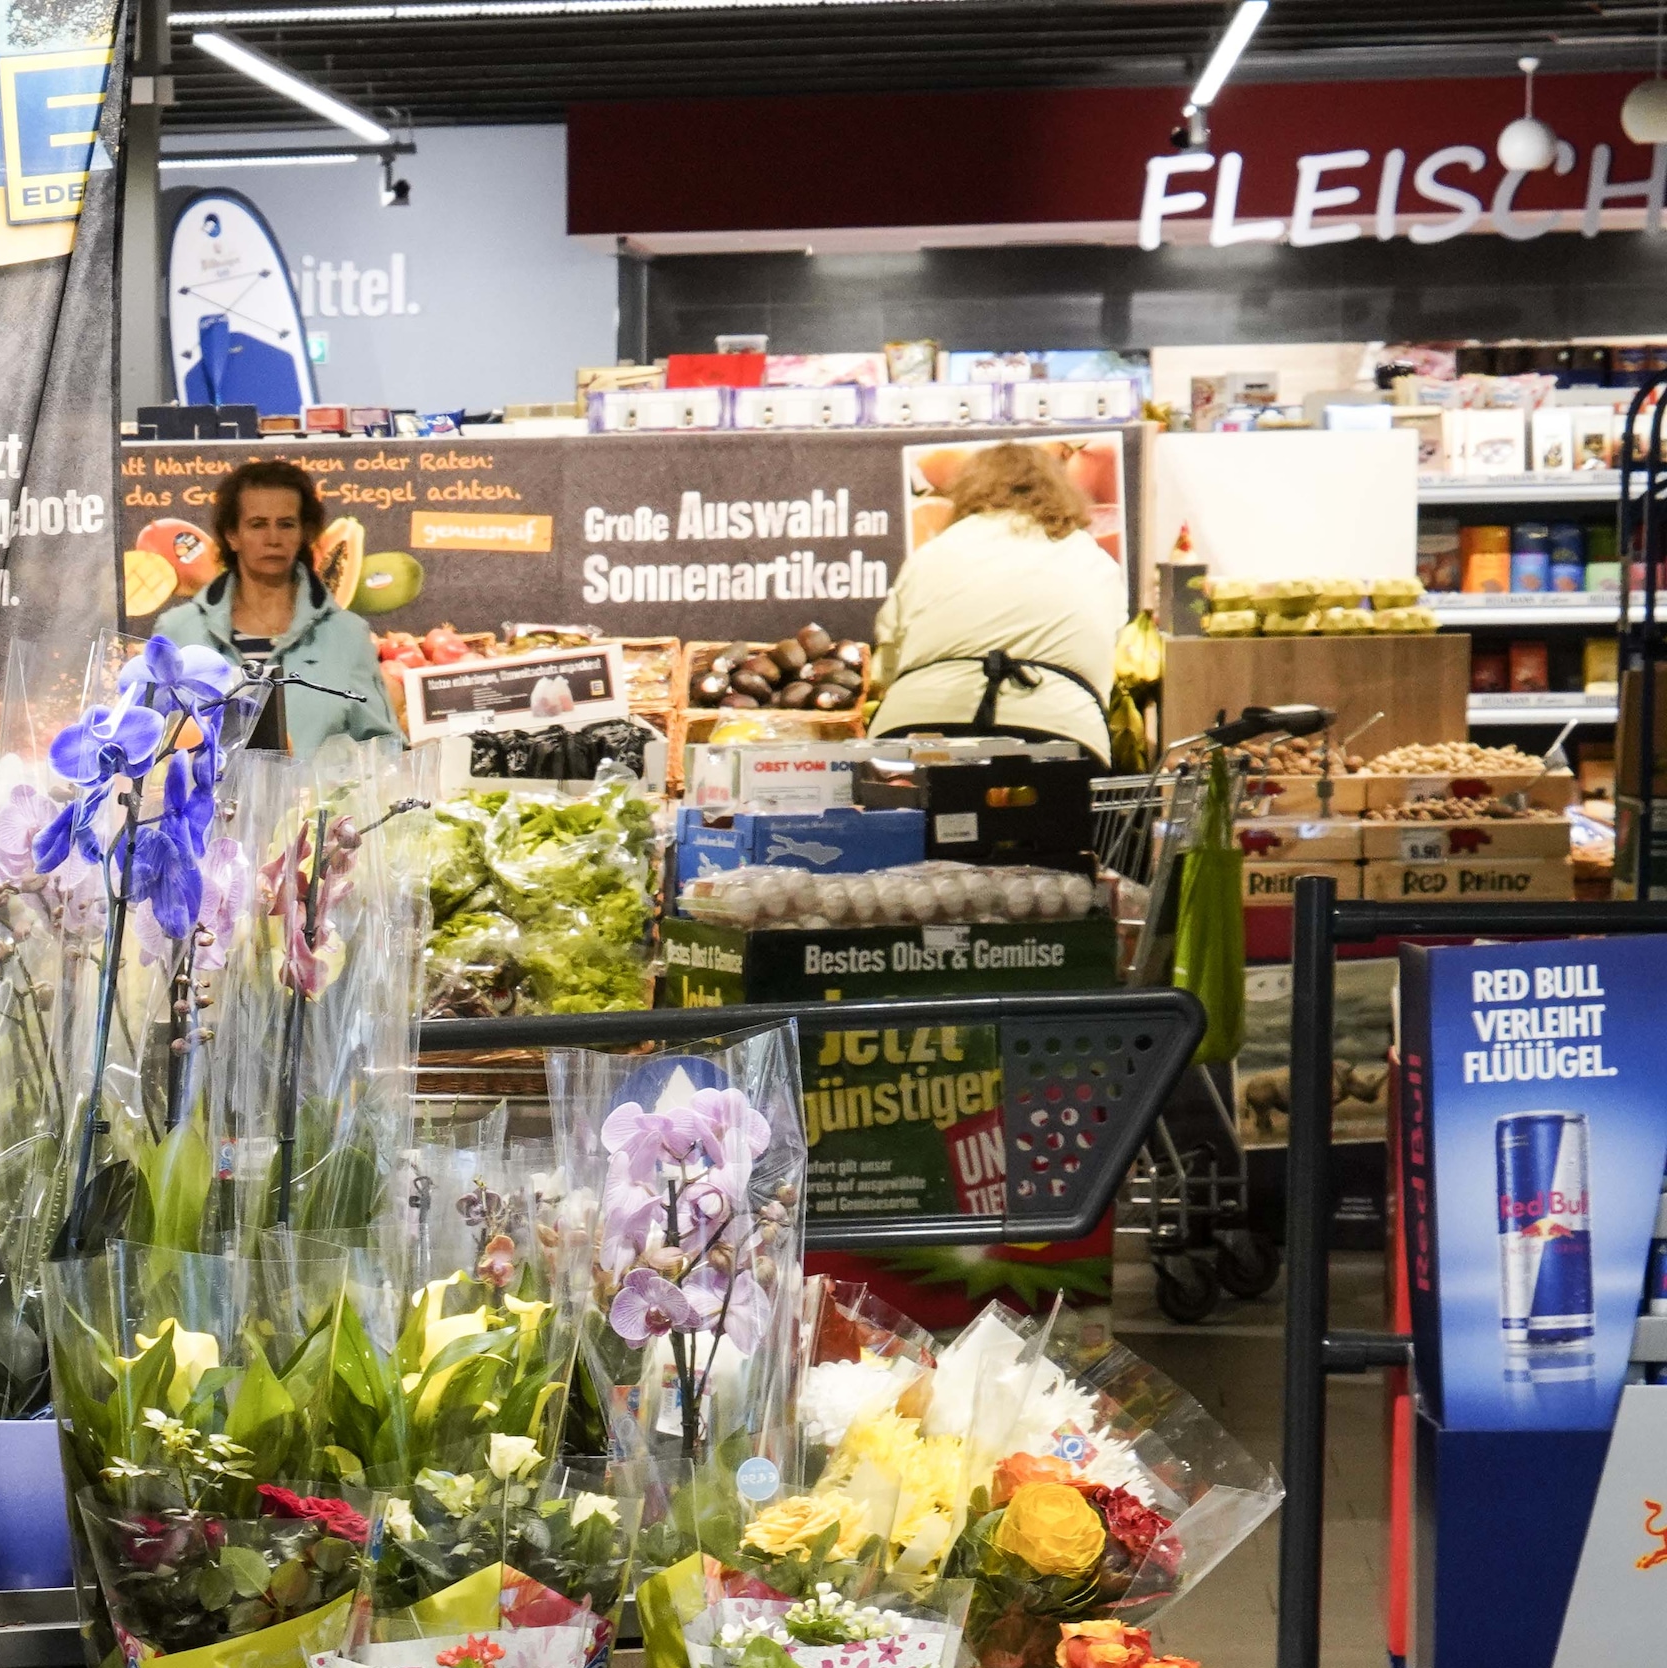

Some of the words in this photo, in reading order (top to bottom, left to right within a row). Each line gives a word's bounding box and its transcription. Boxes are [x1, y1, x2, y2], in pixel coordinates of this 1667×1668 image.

[22, 182, 86, 207] EDE
[1138, 144, 1667, 253] FLEISCH
[288, 252, 422, 318] ittel.
[353, 450, 411, 471] oder
[419, 450, 494, 472] Raten:
[126, 483, 172, 506] das
[426, 479, 522, 501] achten.
[422, 519, 538, 543] genussreif
[584, 505, 670, 543] Große
[677, 488, 848, 541] Auswahl
[854, 507, 888, 537] an
[583, 550, 889, 604] Sonnenartikeln
[753, 761, 789, 773] OBST
[793, 760, 827, 772] VOM
[804, 943, 886, 975] Bestes
[892, 939, 946, 972] Obst
[972, 938, 1066, 970] Gemüse
[1472, 968, 1530, 1004] RED
[1534, 964, 1605, 1000] BULL
[1472, 1004, 1606, 1043] VERLEIHT
[1463, 1040, 1619, 1084] FLÜÜÜGEL.
[806, 1065, 1003, 1148] günstiger
[1406, 1053, 1427, 1164] Bull
[1500, 1191, 1545, 1220] Red
[1412, 1175, 1431, 1292] Red
